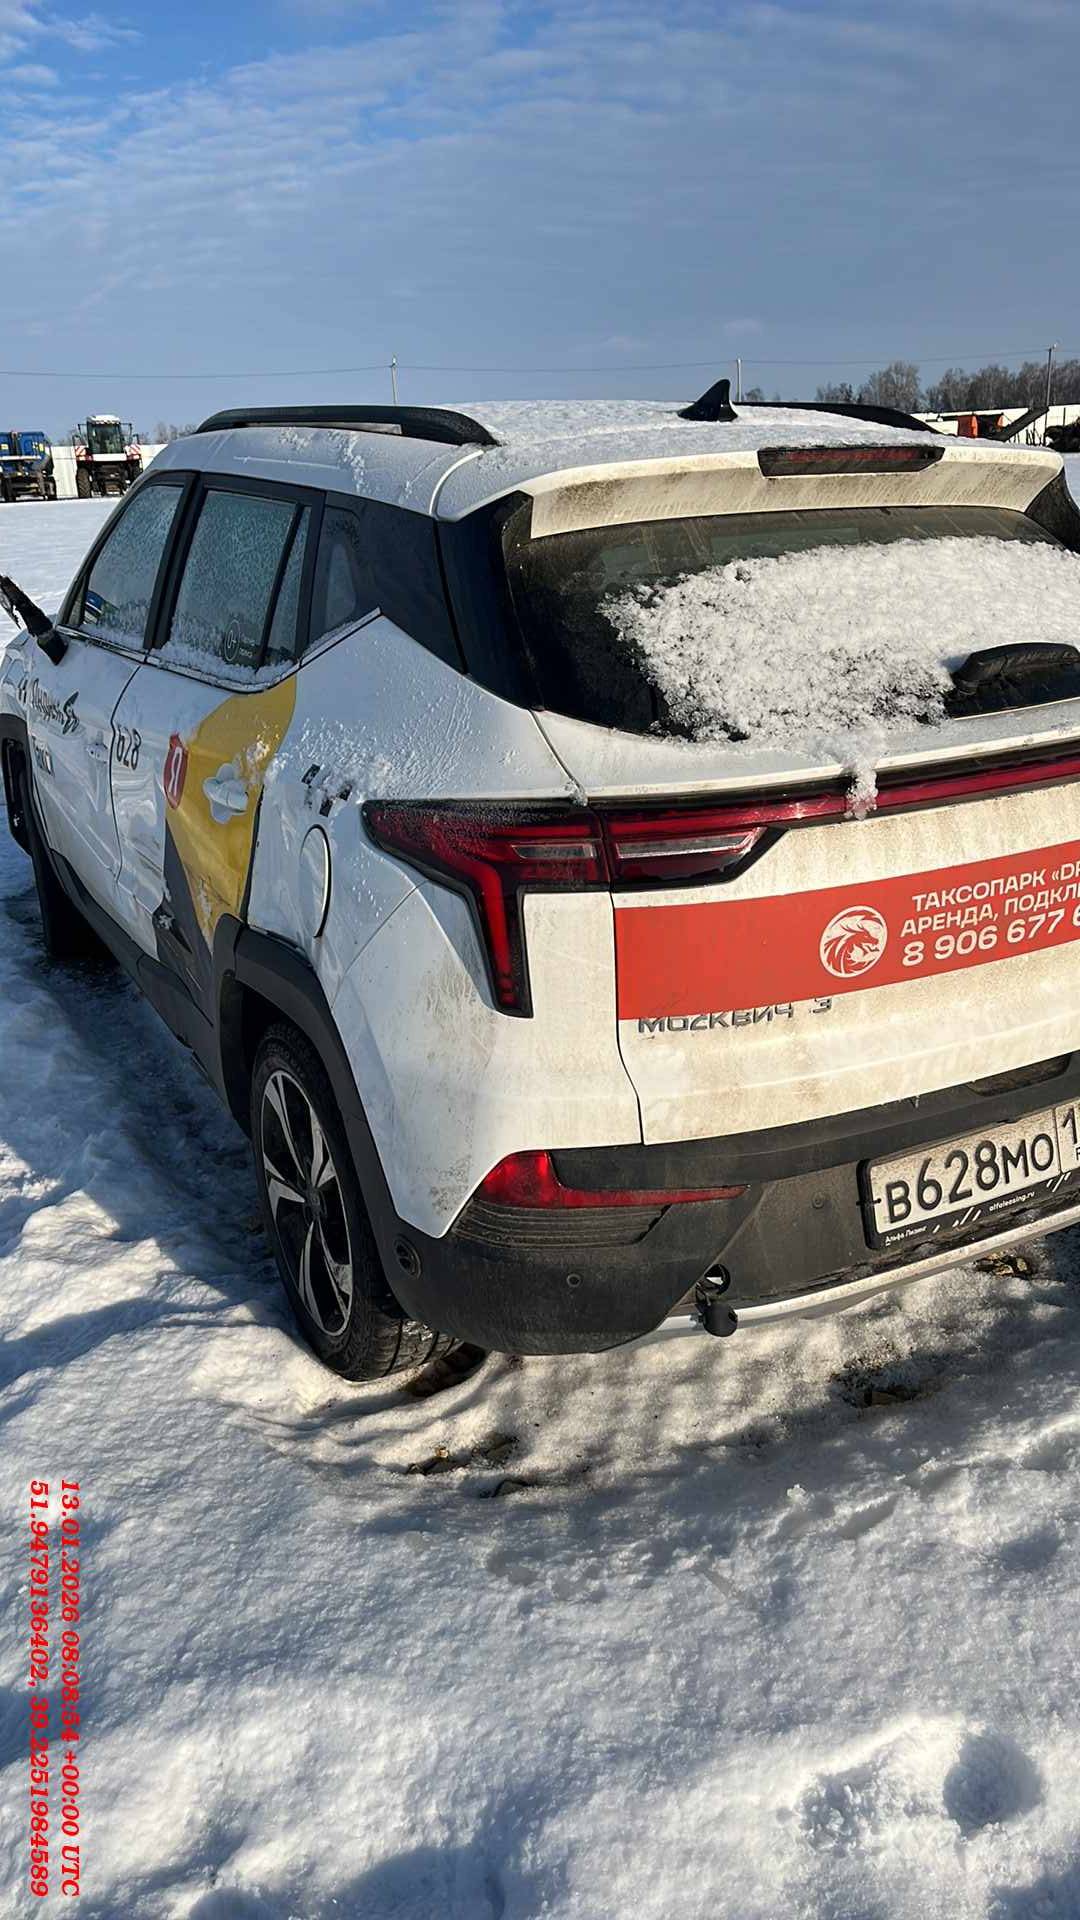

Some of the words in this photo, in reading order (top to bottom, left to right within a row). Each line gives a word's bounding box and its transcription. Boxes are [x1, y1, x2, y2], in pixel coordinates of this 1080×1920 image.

[116, 723, 142, 770] 628
[900, 903, 998, 937] АРЕНДА,
[1004, 882, 1080, 915] ПОДКЛ
[912, 868, 1047, 912] ТАКСОПАРК
[902, 941, 925, 966] 8
[934, 925, 998, 960] 906
[1006, 908, 1064, 943] 677
[885, 1132, 1054, 1223] В628МО
